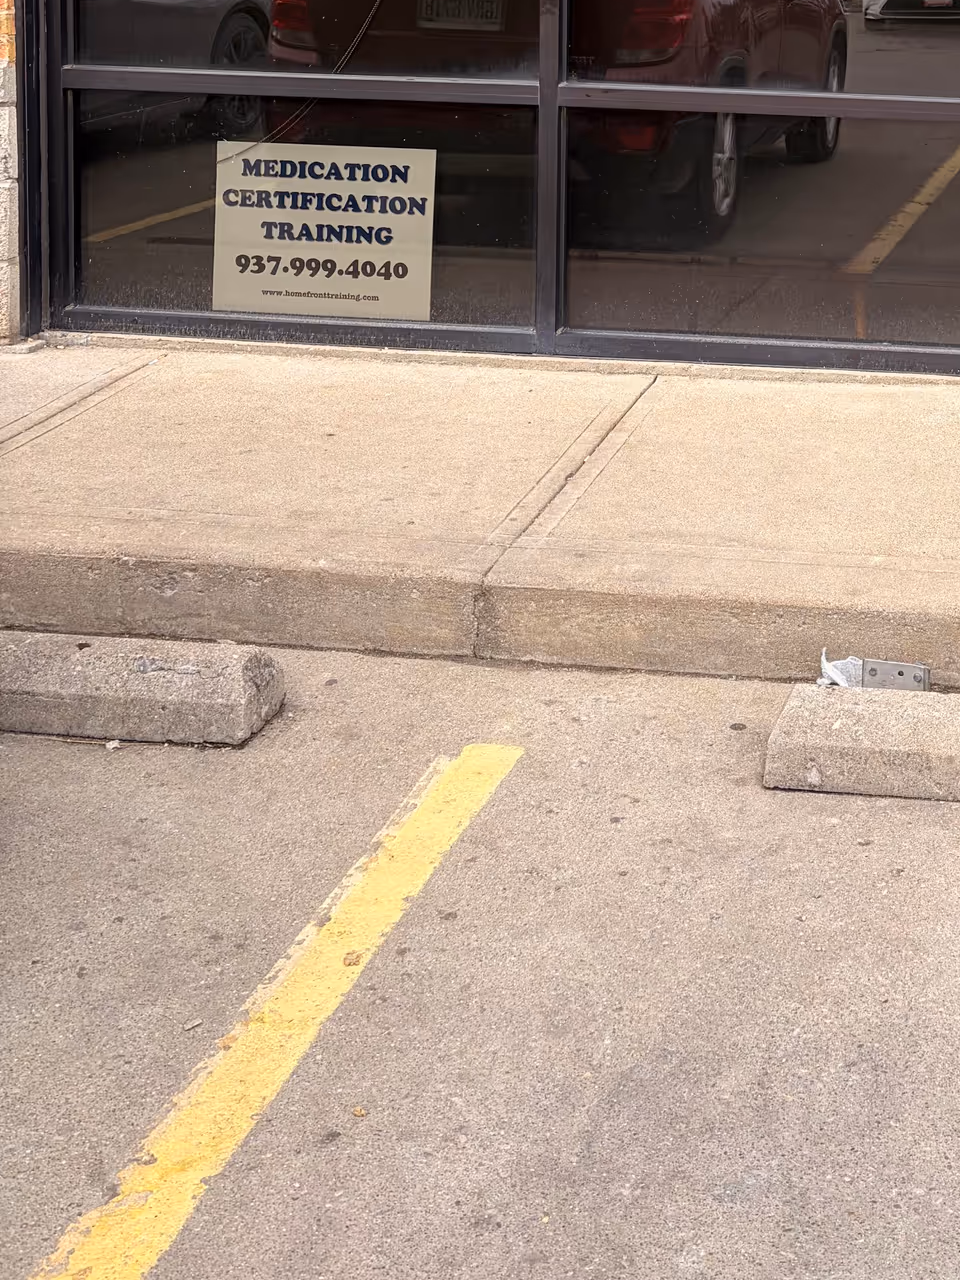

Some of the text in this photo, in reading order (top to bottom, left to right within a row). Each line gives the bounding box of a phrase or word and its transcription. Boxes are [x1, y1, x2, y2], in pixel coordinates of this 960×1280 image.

[241, 158, 410, 183] MEDICATION
[222, 188, 428, 216] CERTIFICATION
[261, 221, 393, 245] TRAINING
[235, 254, 409, 280] 937.999.4040
[261, 289, 380, 302] www.homefronttraining.com
